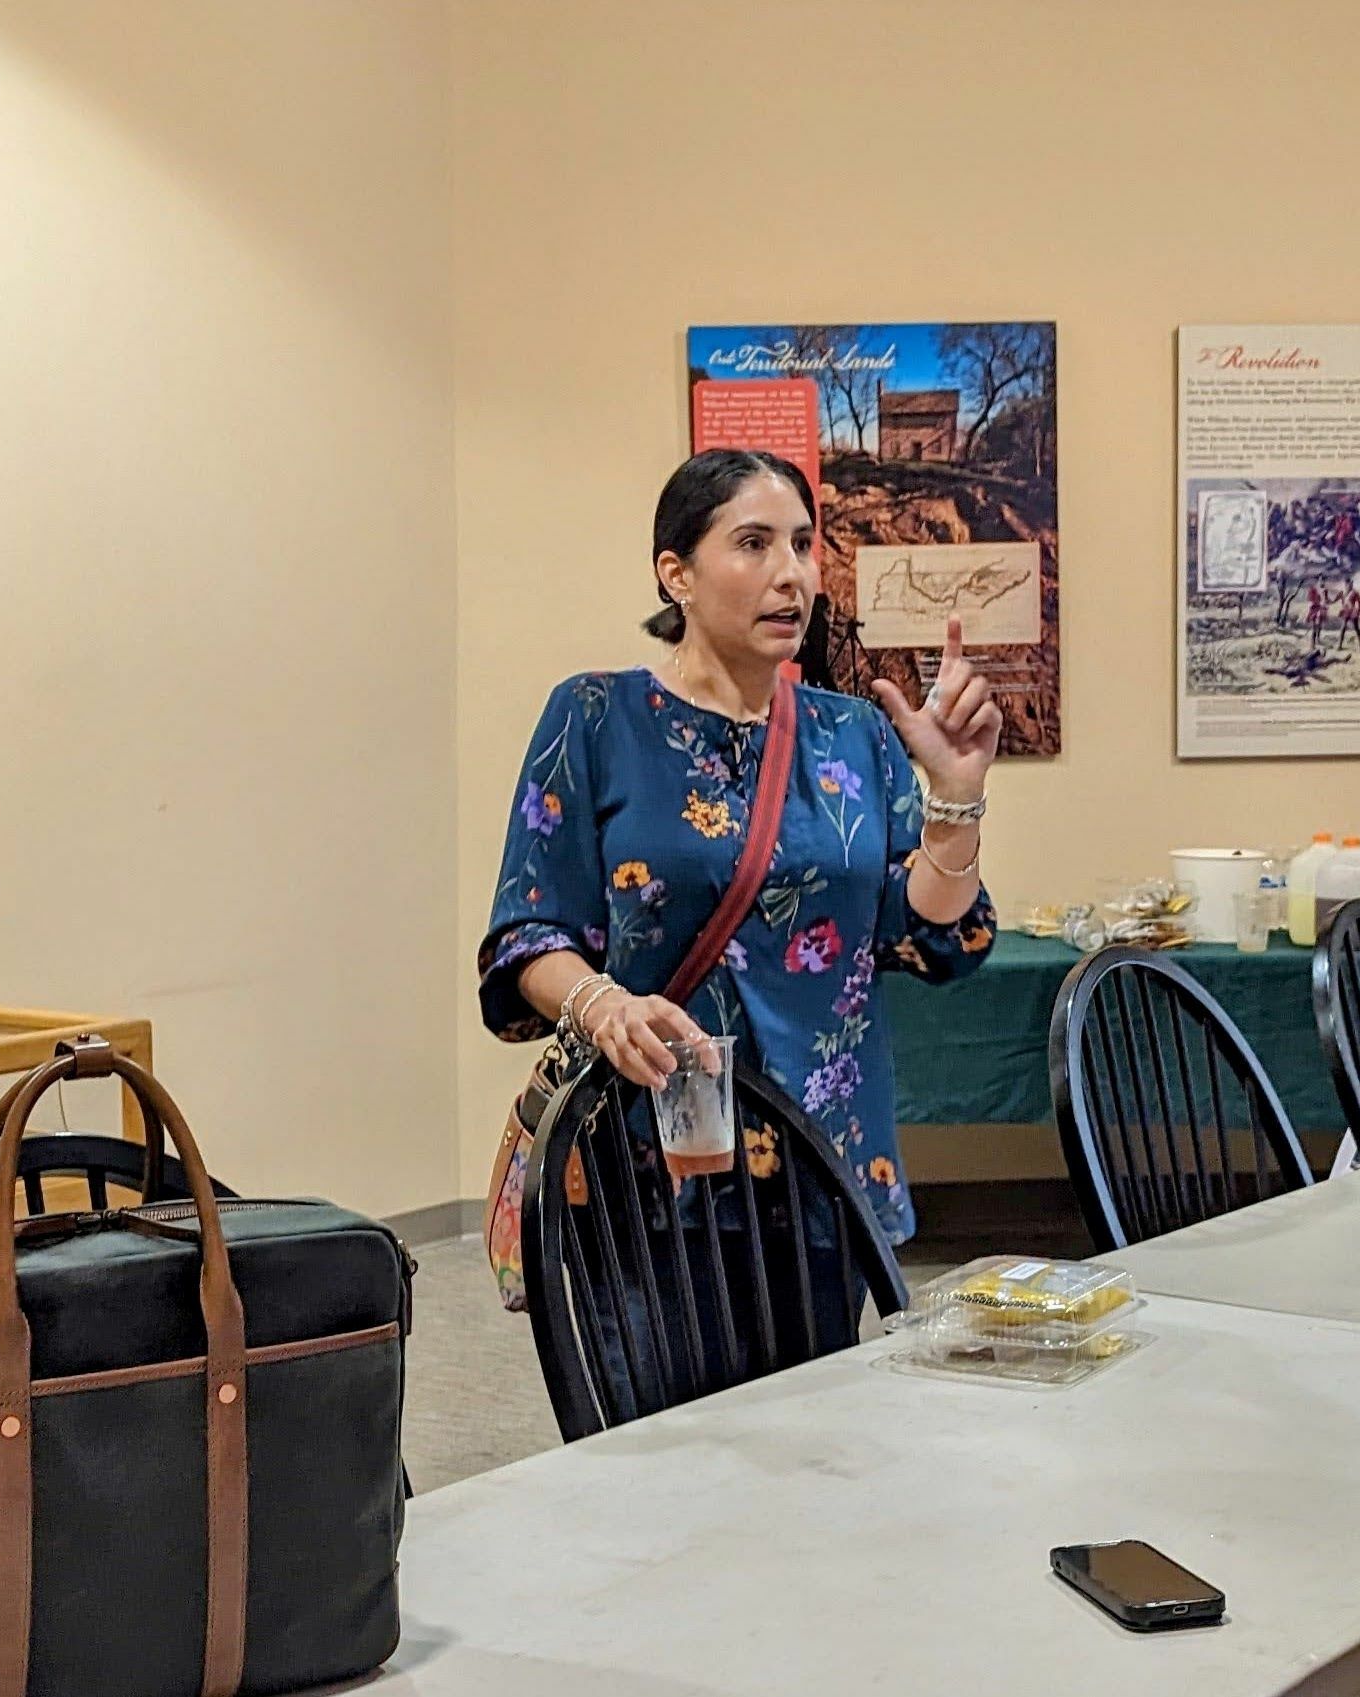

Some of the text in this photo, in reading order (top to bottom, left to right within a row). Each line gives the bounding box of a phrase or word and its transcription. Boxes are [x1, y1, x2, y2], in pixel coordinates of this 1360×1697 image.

[735, 339, 834, 371] Territorial
[833, 343, 897, 371] Lands
[1217, 344, 1321, 370] Revolution
